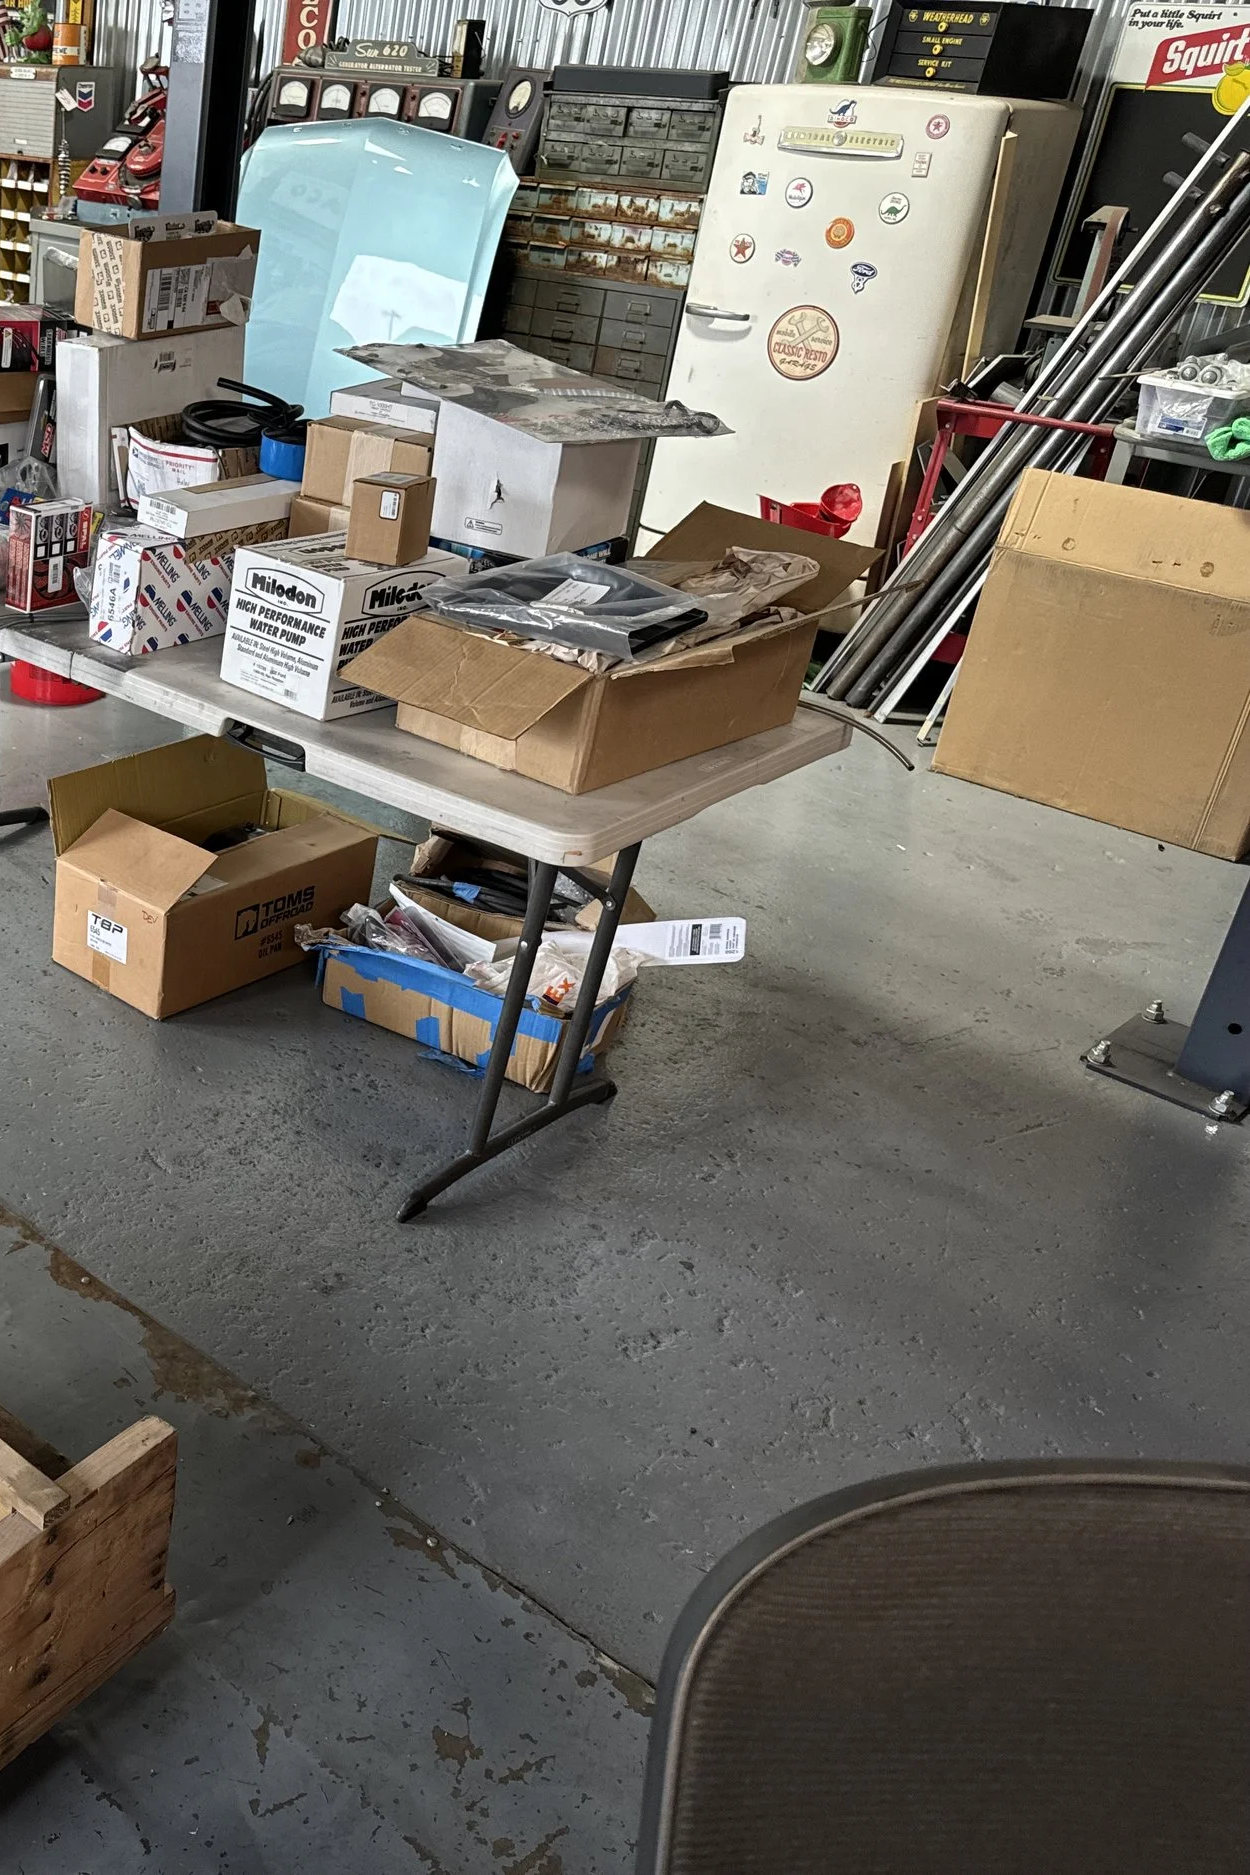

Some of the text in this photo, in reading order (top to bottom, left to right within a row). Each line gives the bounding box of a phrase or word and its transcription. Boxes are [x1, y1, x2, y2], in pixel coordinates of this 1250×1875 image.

[923, 11, 974, 24] WEATHERHEAD
[1128, 18, 1184, 30] in your life.
[1132, 8, 1151, 18] Put
[1160, 9, 1185, 19] little
[1186, 10, 1223, 22] Squirt
[355, 42, 408, 58] Sun 620
[922, 36, 963, 45] SMALL ENGINE
[1162, 27, 1250, 76] Squirt
[338, 61, 368, 70] GENERATOR
[403, 65, 422, 73] TESTER
[917, 59, 939, 67] SERVICE
[849, 136, 896, 147] ELECTRIC
[853, 264, 875, 276] Ford
[773, 341, 828, 363] CLASSIC RESTO
[155, 550, 181, 584] MELLING
[251, 572, 317, 609] Milodon
[152, 596, 178, 627] MELLING
[190, 601, 213, 632] MELLING
[235, 597, 327, 639] HIGH PERFORMANCE
[249, 617, 306, 647] WATER PUMP
[341, 623, 366, 641] HIGH
[231, 632, 253, 647] AVAILABLE
[270, 646, 281, 657] High
[262, 885, 316, 917] TOMS
[91, 913, 124, 934] TBP
[260, 901, 314, 930] OFFROAD
[260, 930, 283, 946] #6545
[258, 942, 282, 959] OIL PAN
